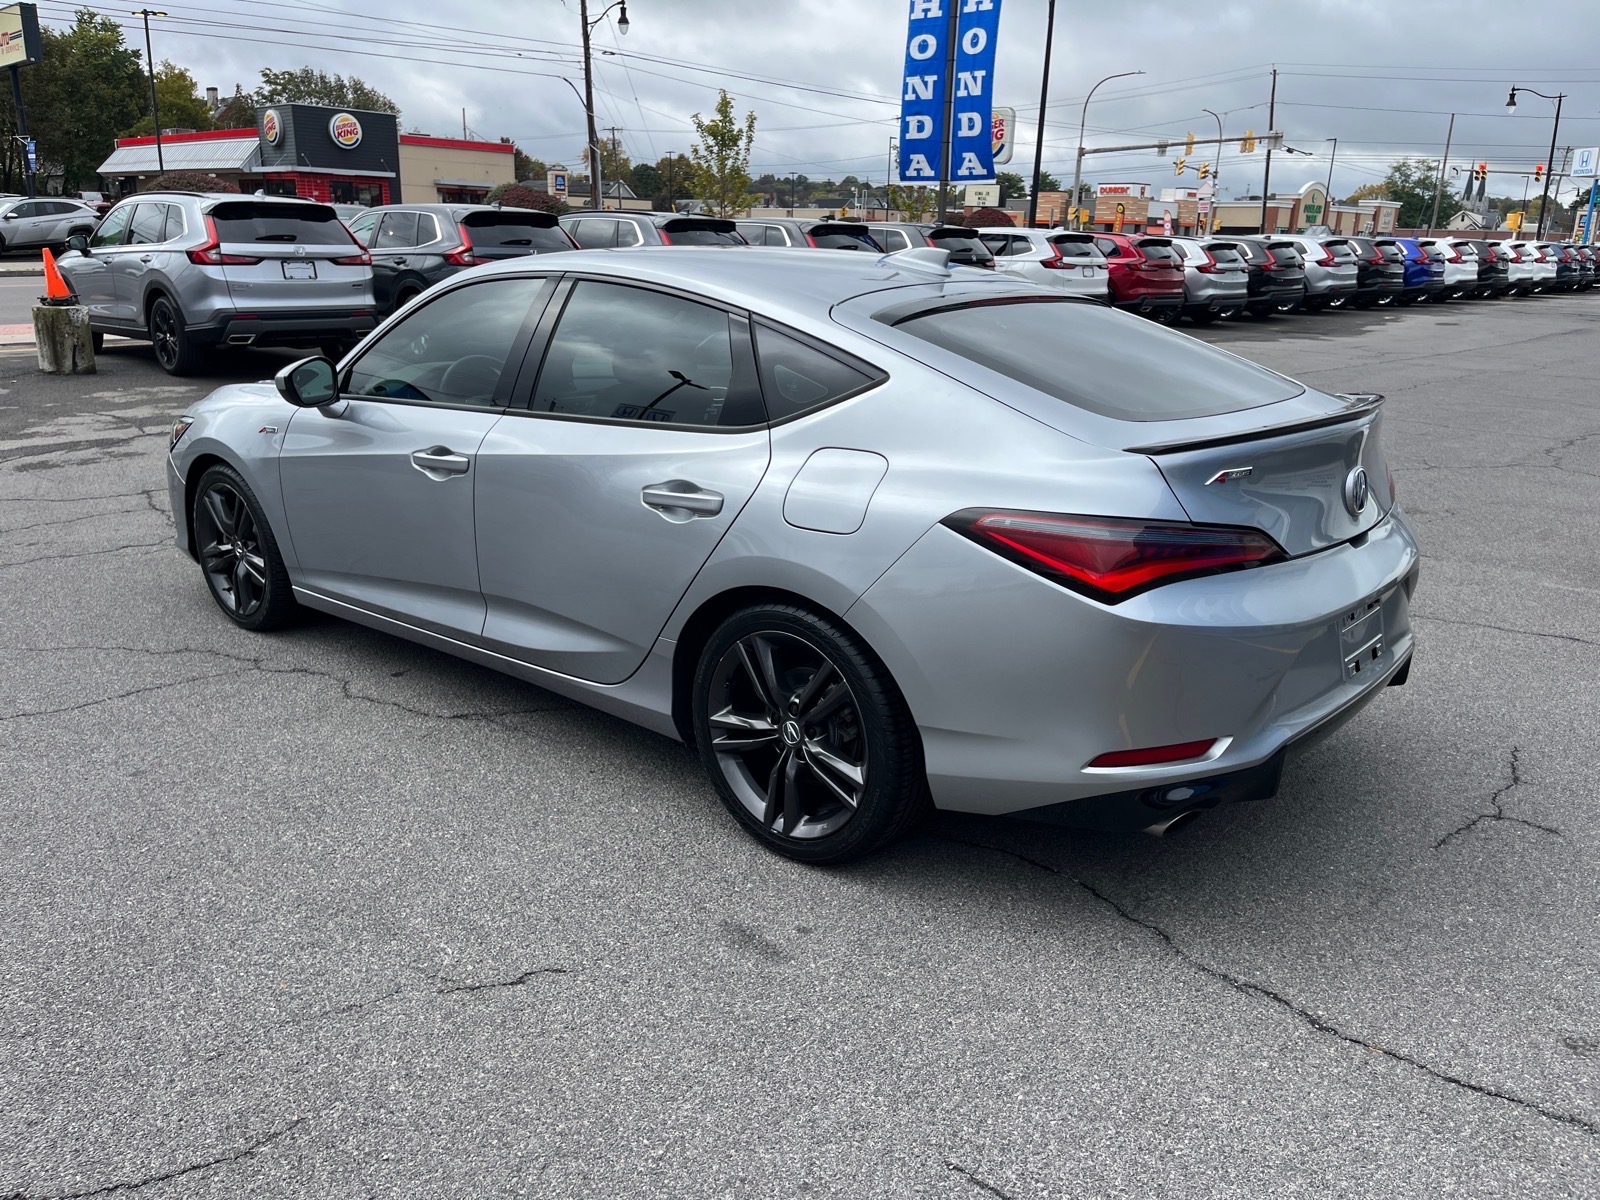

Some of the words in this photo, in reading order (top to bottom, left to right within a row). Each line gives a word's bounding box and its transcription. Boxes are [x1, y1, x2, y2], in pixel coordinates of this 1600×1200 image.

[904, 0, 943, 177] HONDA
[335, 121, 357, 131] BURGER
[336, 128, 359, 139] KING
